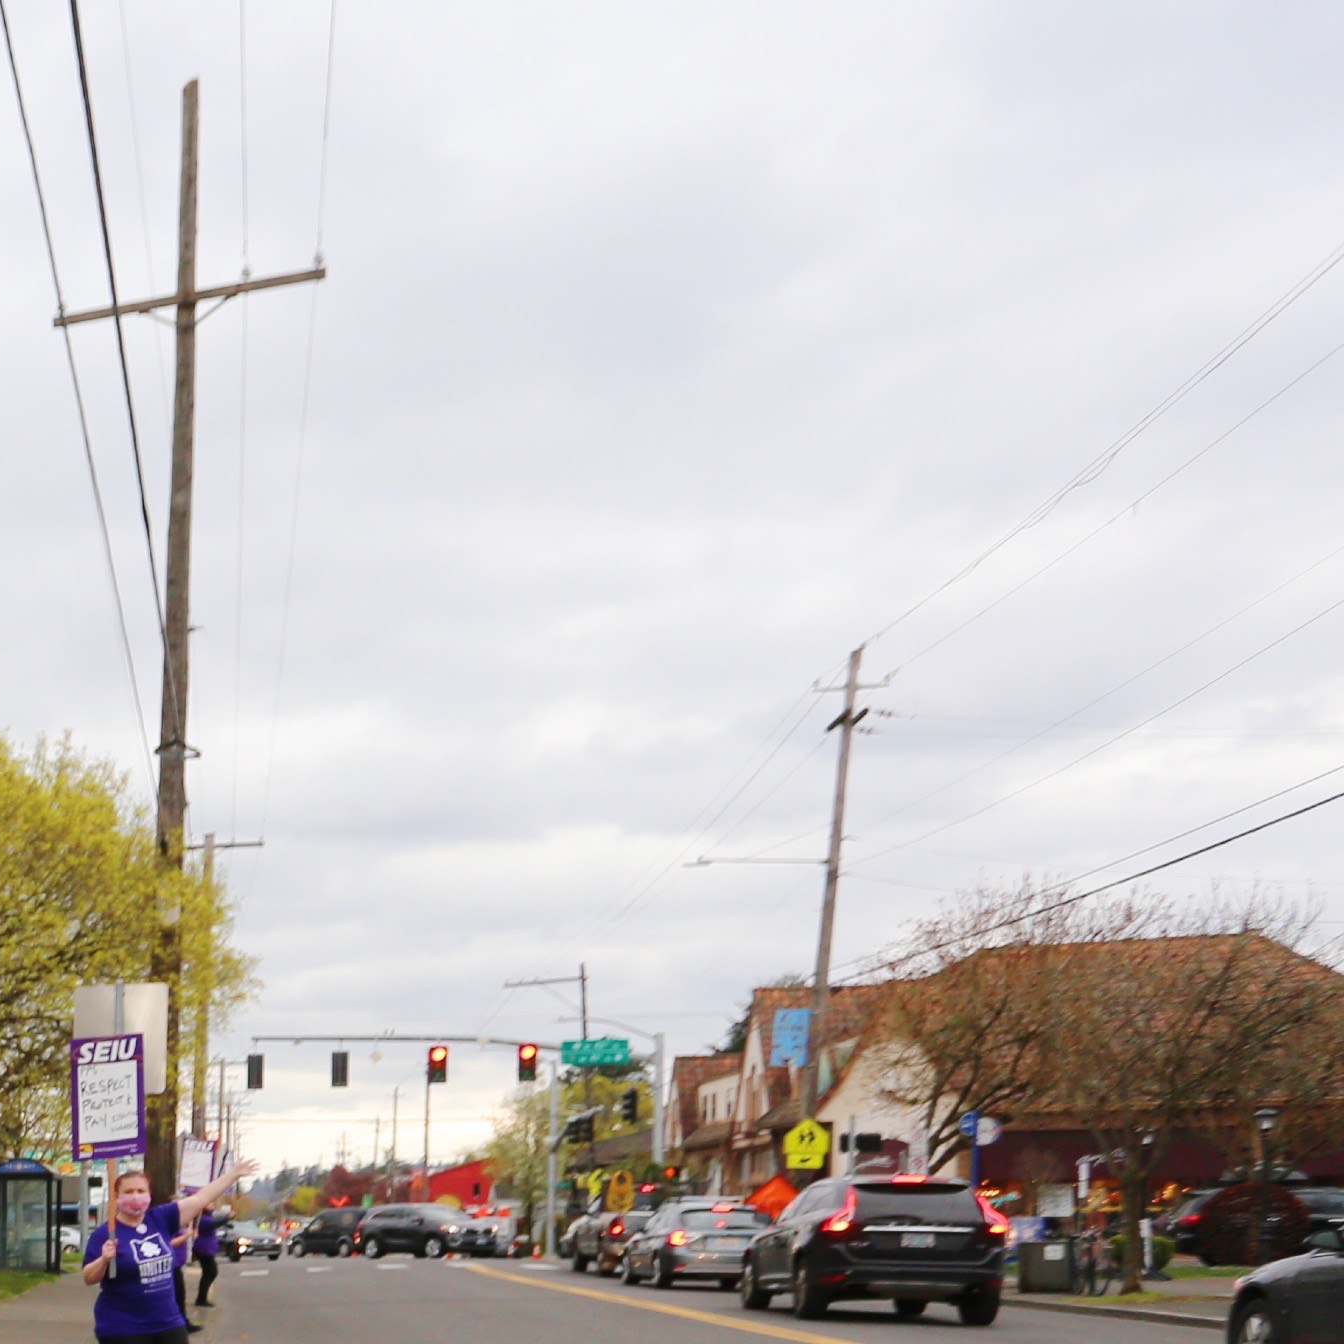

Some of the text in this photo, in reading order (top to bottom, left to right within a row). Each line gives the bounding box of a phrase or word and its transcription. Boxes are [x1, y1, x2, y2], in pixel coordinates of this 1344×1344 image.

[77, 1037, 138, 1065] SEIU
[80, 1074, 133, 1098] RESPECT
[83, 1113, 108, 1132] PAY
